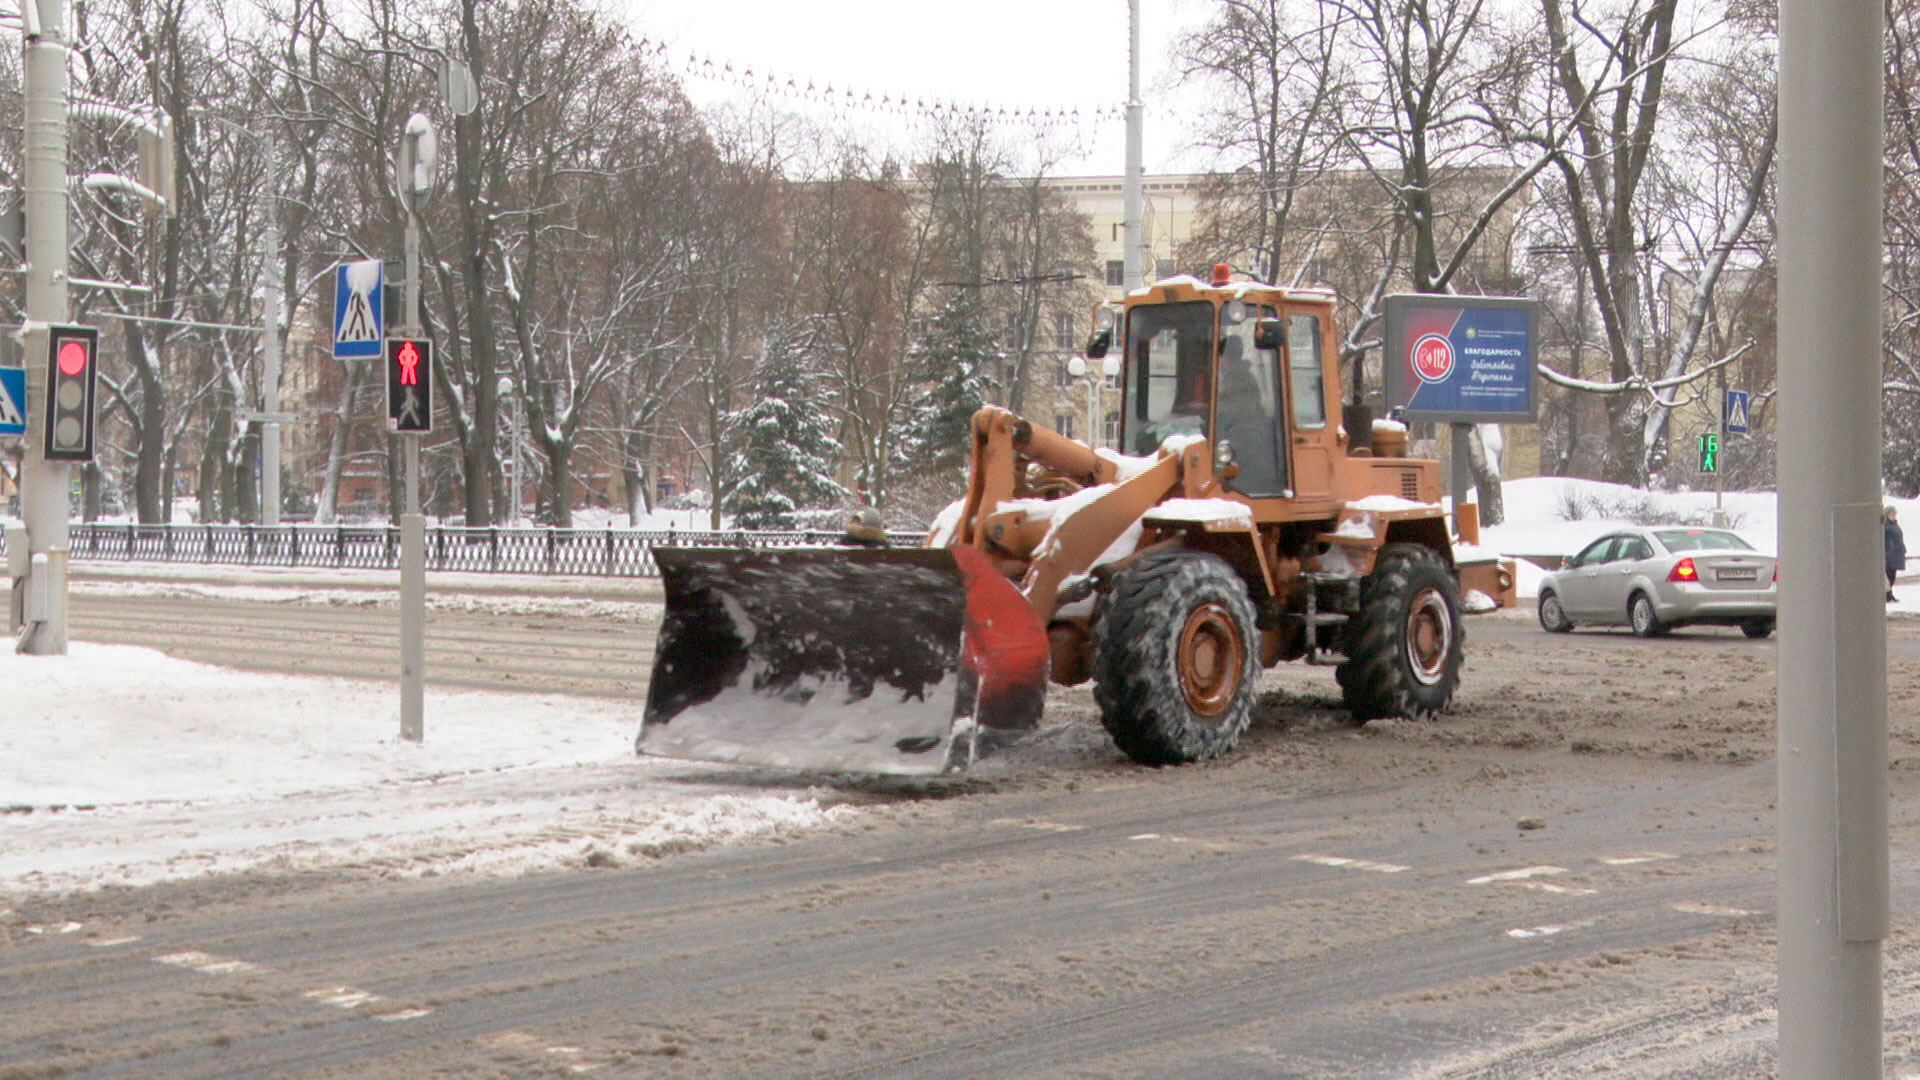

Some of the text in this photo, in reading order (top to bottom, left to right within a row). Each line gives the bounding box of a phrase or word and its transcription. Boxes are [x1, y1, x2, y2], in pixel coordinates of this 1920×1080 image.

[1433, 348, 1446, 369] 112
[1465, 347, 1521, 356] БЛАГОДАРНОСТЬ
[1700, 435, 1717, 453] 16
